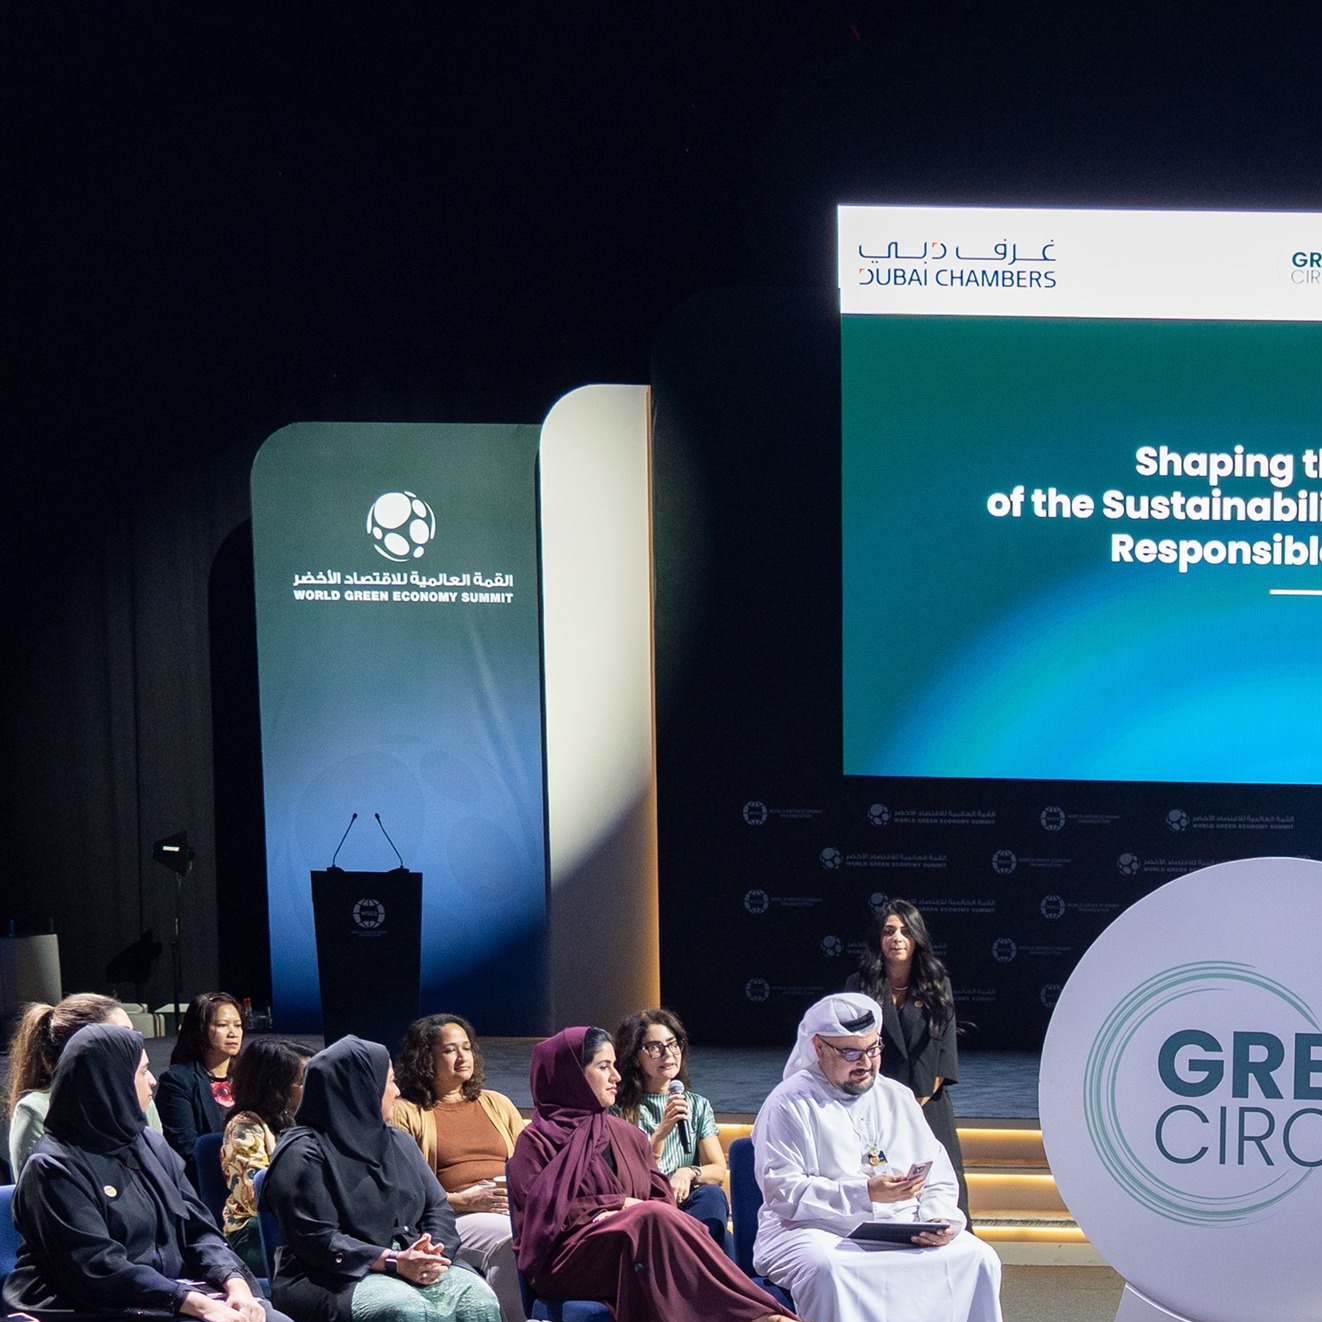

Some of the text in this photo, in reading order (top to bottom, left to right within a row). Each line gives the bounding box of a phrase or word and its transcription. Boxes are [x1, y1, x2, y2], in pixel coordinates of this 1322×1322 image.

[859, 239, 1056, 265] غرف دبي
[860, 268, 1056, 288] DUBAI CHAMBERS
[1136, 445, 1293, 489] Shaping
[987, 486, 1024, 516] of
[1031, 488, 1094, 518] the
[293, 570, 513, 588] القمة العالمية للاقتصاد الأخضر
[294, 590, 513, 603] WORLD GREEN ECONOMY SUMMIT
